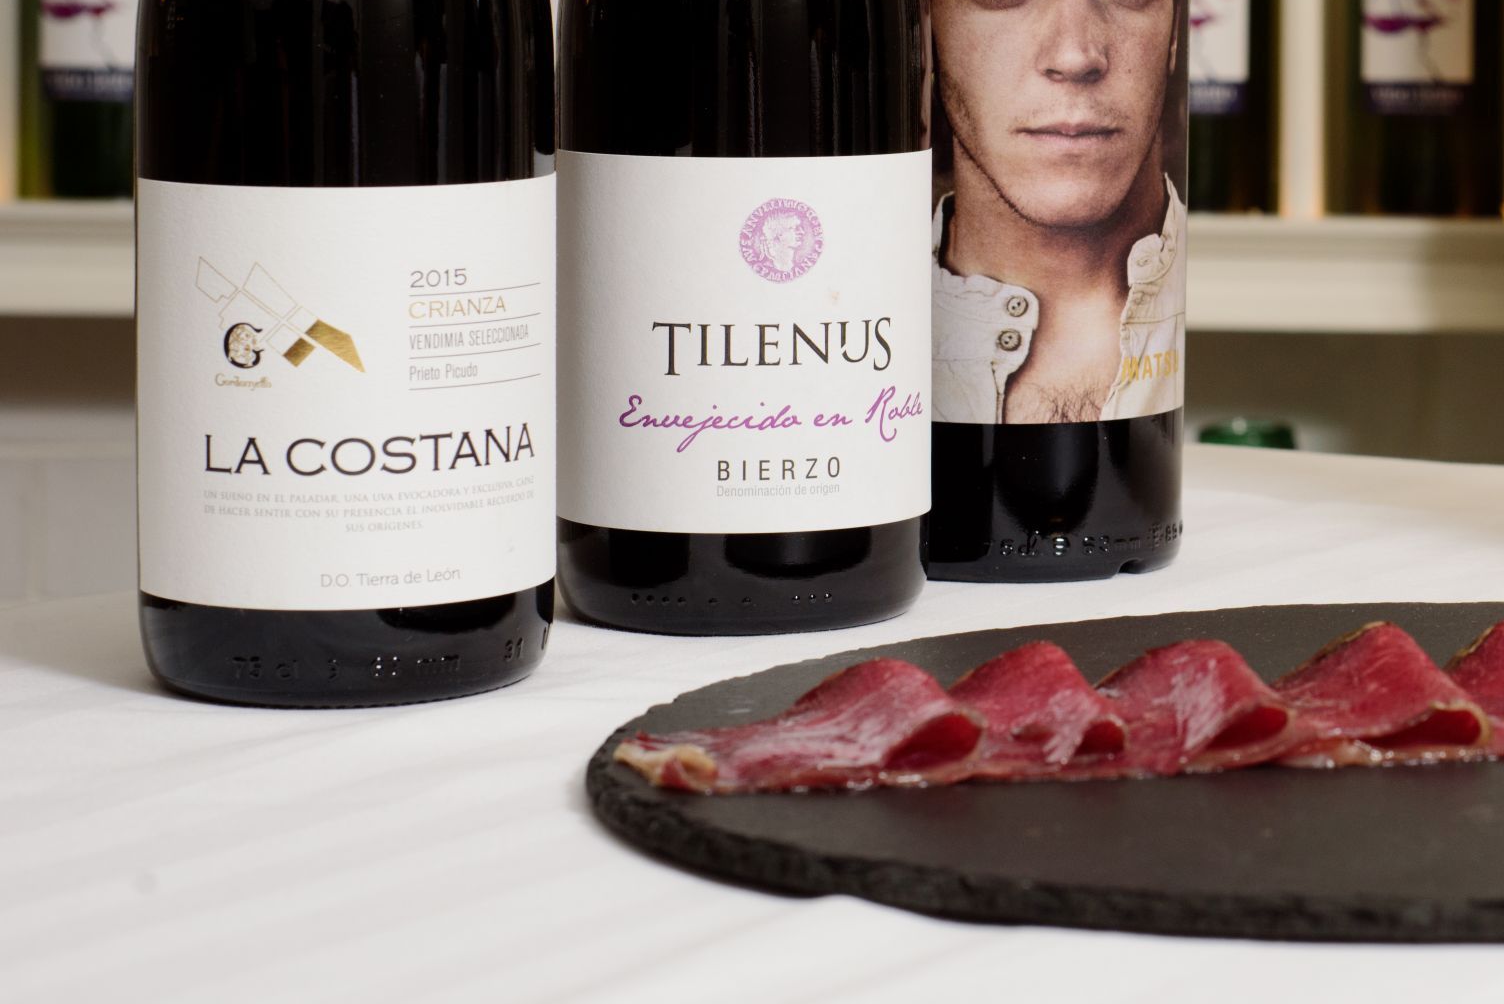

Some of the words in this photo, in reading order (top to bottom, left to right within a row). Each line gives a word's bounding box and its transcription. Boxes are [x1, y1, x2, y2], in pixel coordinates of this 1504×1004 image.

[409, 267, 468, 289] 2015
[408, 295, 507, 320] CRIANZA
[409, 331, 466, 351] VENDIMIA
[468, 323, 529, 347] SELECCIONADA
[651, 316, 893, 376] TILENUS
[408, 365, 441, 382] Prieto
[445, 361, 479, 380] Picudo
[618, 394, 803, 454] Envejecido
[812, 410, 853, 430] en
[864, 385, 924, 443] Roble
[204, 433, 272, 476] LA
[285, 422, 536, 477] COSTANA
[716, 456, 842, 482] BIERZO
[256, 492, 271, 503] EN
[344, 493, 369, 503] UNA
[373, 491, 394, 502] UVA
[398, 487, 461, 501] EVOCADORA
[716, 483, 792, 498] Denominación
[795, 484, 807, 496] de
[809, 483, 841, 498] origen
[219, 506, 251, 517] HACER
[254, 507, 290, 518] SENTIR
[295, 508, 321, 519] CON
[325, 508, 339, 519] SU
[343, 506, 403, 519] PRESENCIA
[421, 499, 484, 514] INOLVIDABLE
[344, 522, 365, 533] SUS
[320, 573, 353, 589] D.O.
[356, 571, 400, 588] Tierra
[403, 568, 423, 585] de
[425, 567, 462, 583] León
